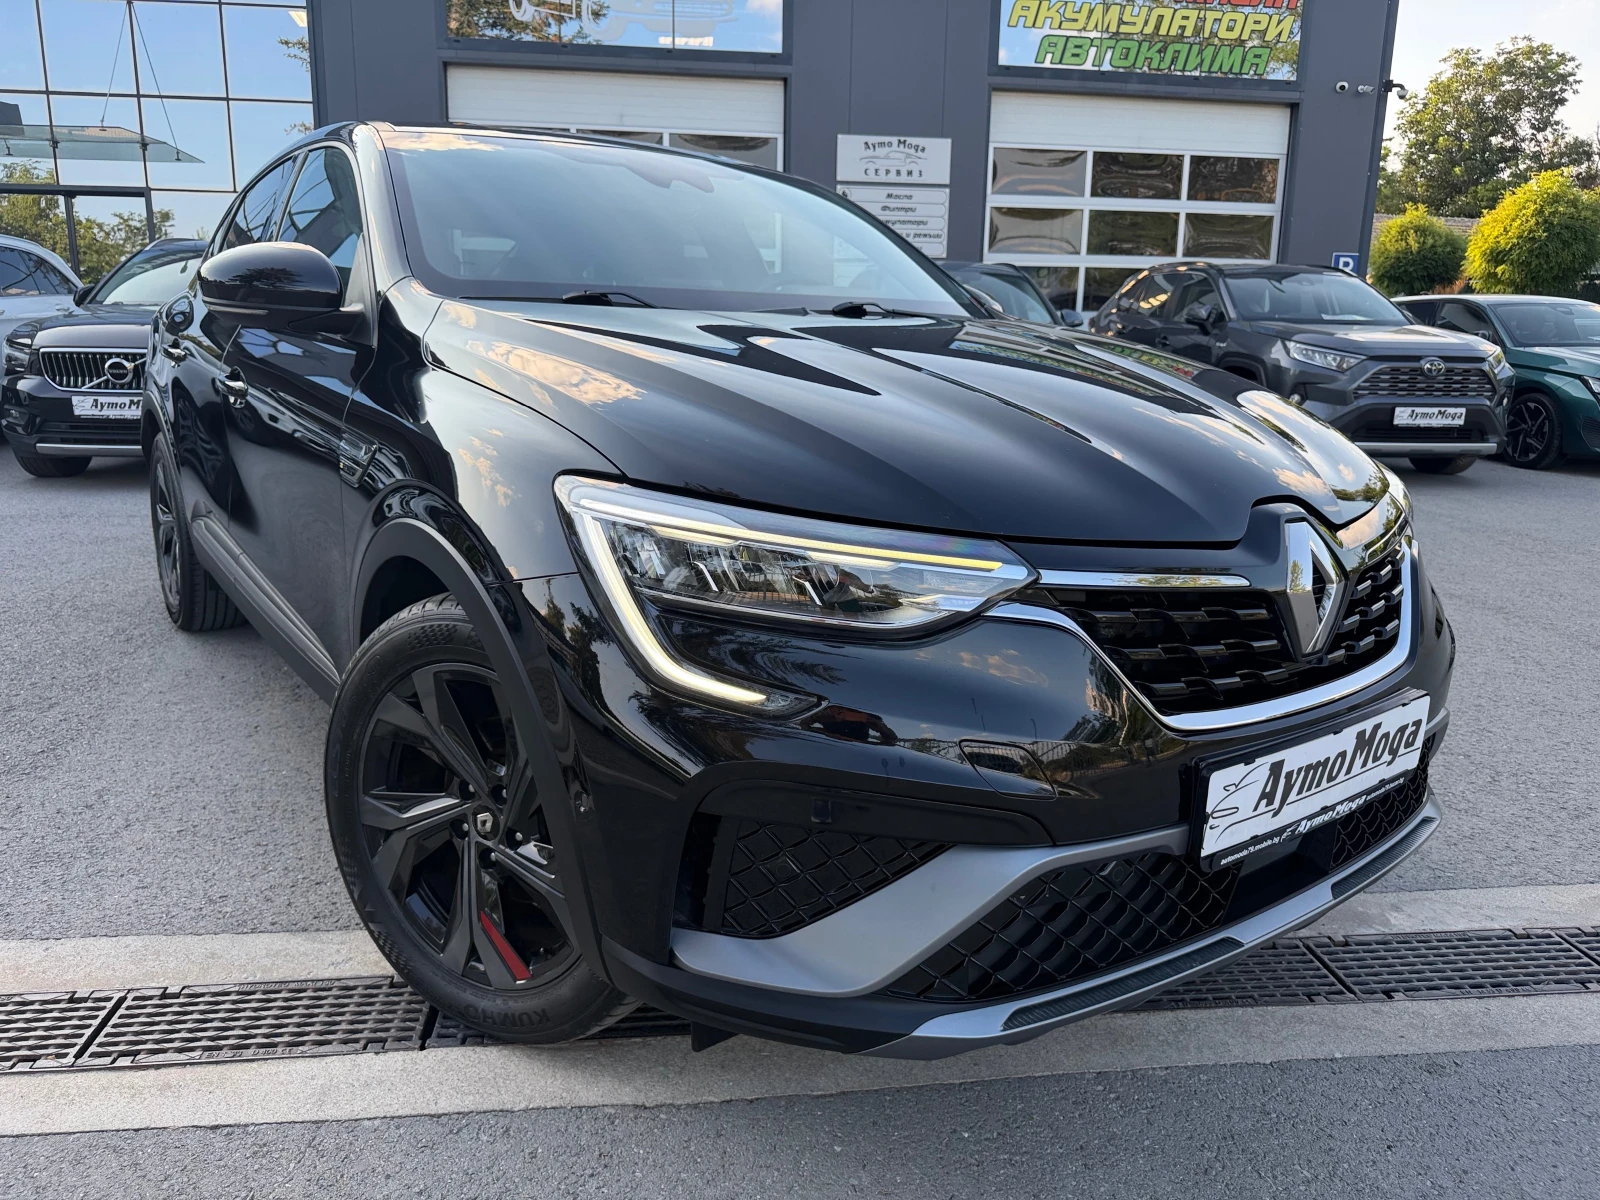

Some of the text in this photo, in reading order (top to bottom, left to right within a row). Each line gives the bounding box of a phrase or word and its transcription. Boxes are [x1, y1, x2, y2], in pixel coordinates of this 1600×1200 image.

[1007, 0, 1296, 43] АКУМУЛАТОРИ
[1034, 34, 1272, 76] АВТОКЛИМА
[864, 168, 923, 178] СЕРВИЗ
[463, 1004, 550, 1028] KUMHO
